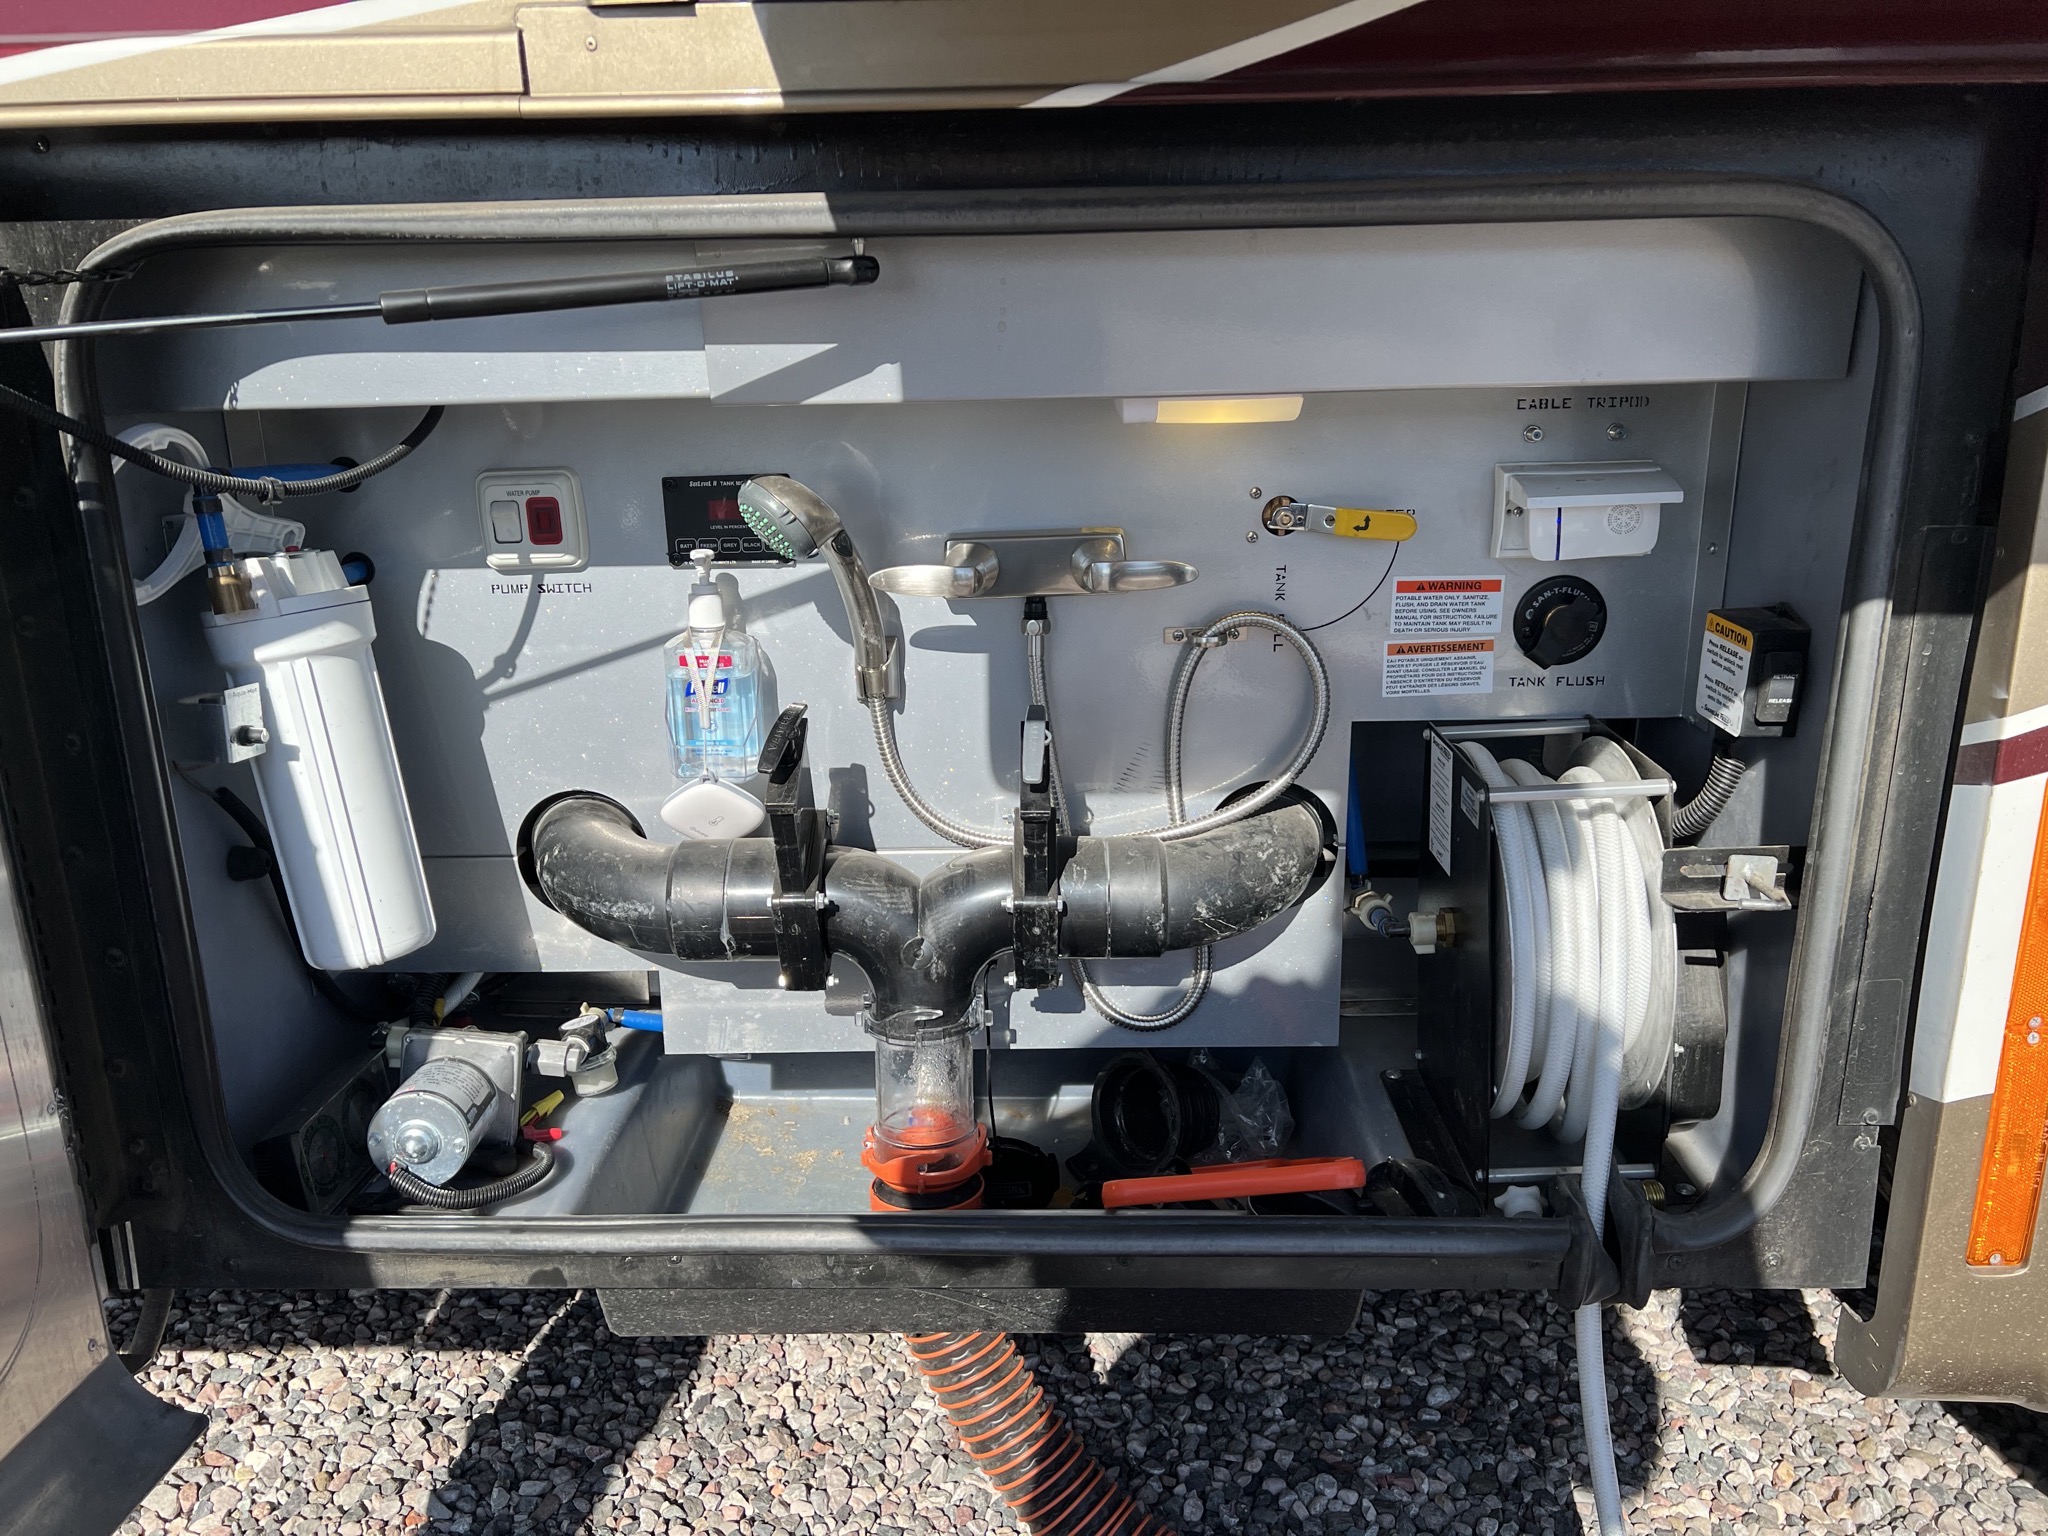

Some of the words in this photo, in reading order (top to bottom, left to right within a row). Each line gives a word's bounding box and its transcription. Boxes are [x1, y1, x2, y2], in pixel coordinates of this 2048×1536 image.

[666, 270, 734, 282] STABILUS
[1517, 398, 1572, 410] CABLE
[1587, 397, 1651, 409] TRIPOD
[491, 584, 529, 594] PUMP
[537, 583, 592, 593] SWITCH
[1275, 565, 1287, 601] TANK
[1428, 582, 1482, 590] WARNING
[1715, 622, 1748, 647] CAUTION
[1407, 642, 1485, 654] AVERTISSEMENT
[1720, 644, 1738, 658] RELEASE
[1509, 677, 1546, 687] TANK
[1556, 676, 1605, 686] FLUSH
[1714, 679, 1734, 694] RETRACT
